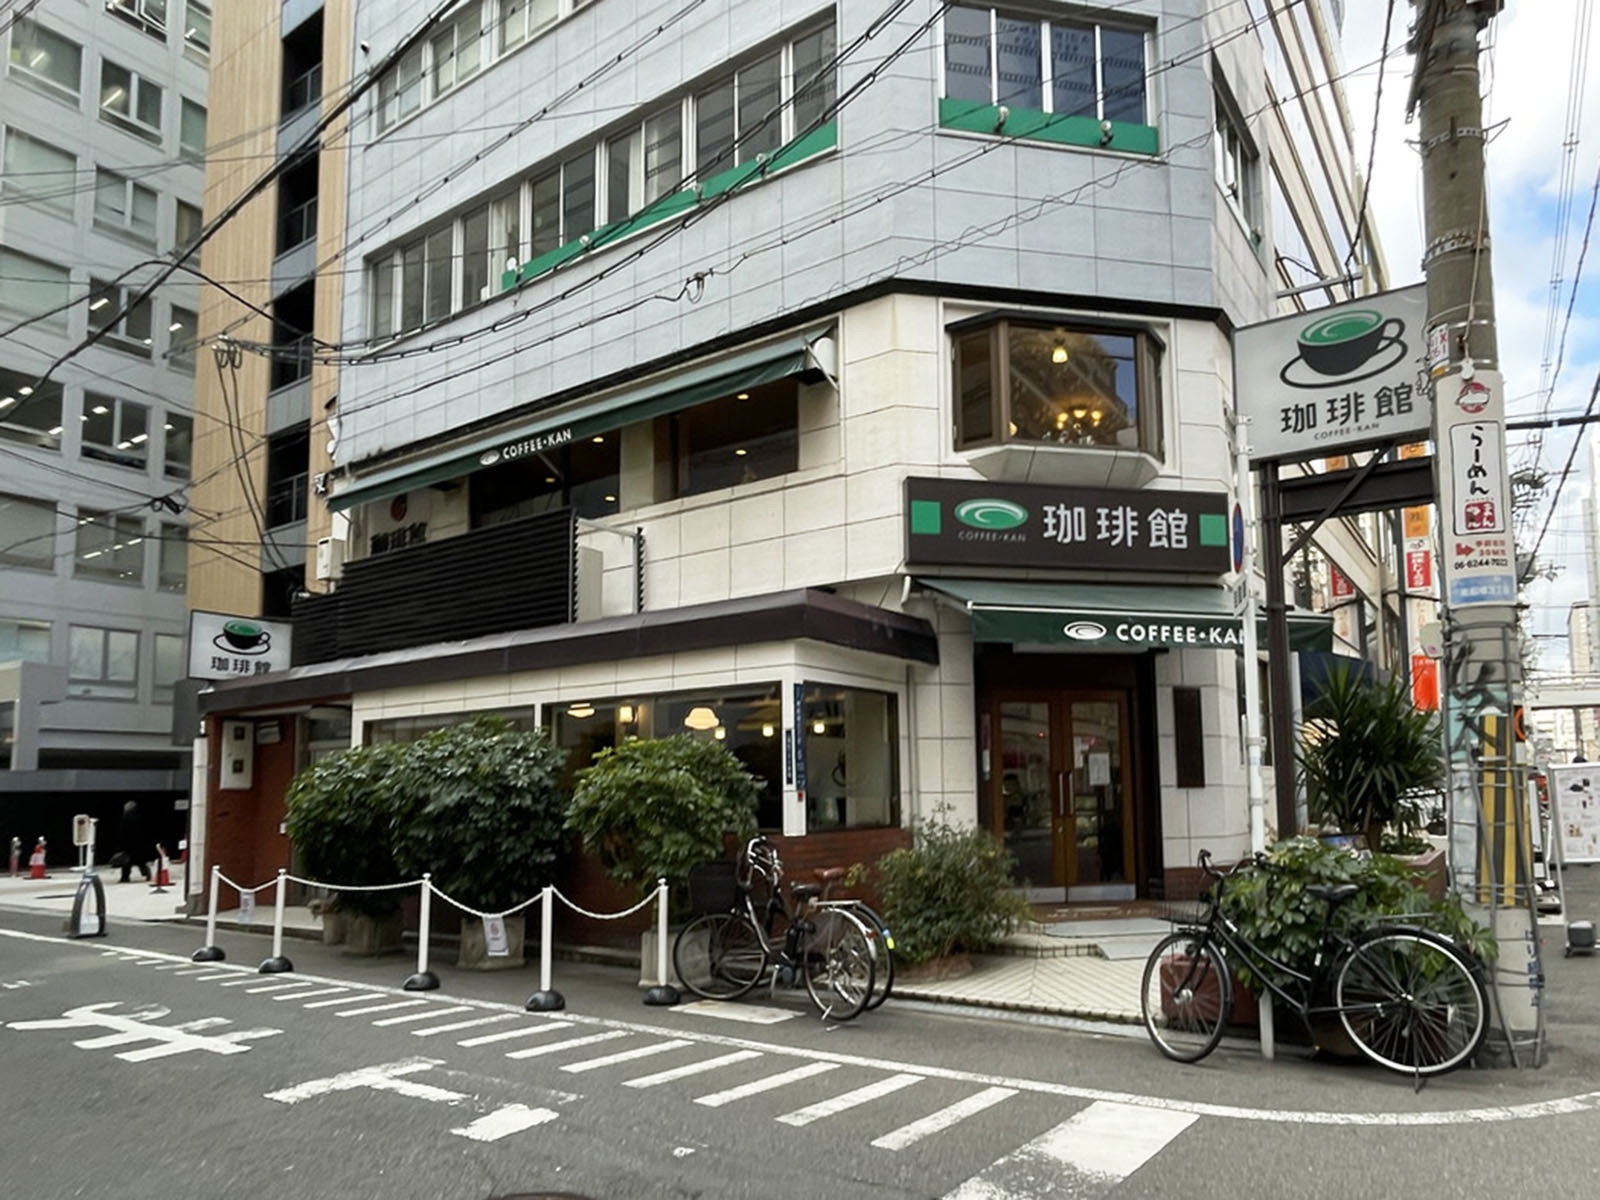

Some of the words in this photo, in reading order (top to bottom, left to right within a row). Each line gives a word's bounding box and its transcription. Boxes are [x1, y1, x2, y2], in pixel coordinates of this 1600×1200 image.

[1280, 382, 1414, 433] 珈琲館
[1467, 425, 1489, 495] らーめん
[1042, 503, 1188, 549] 珈琲館
[210, 656, 272, 675] 珈琲館
